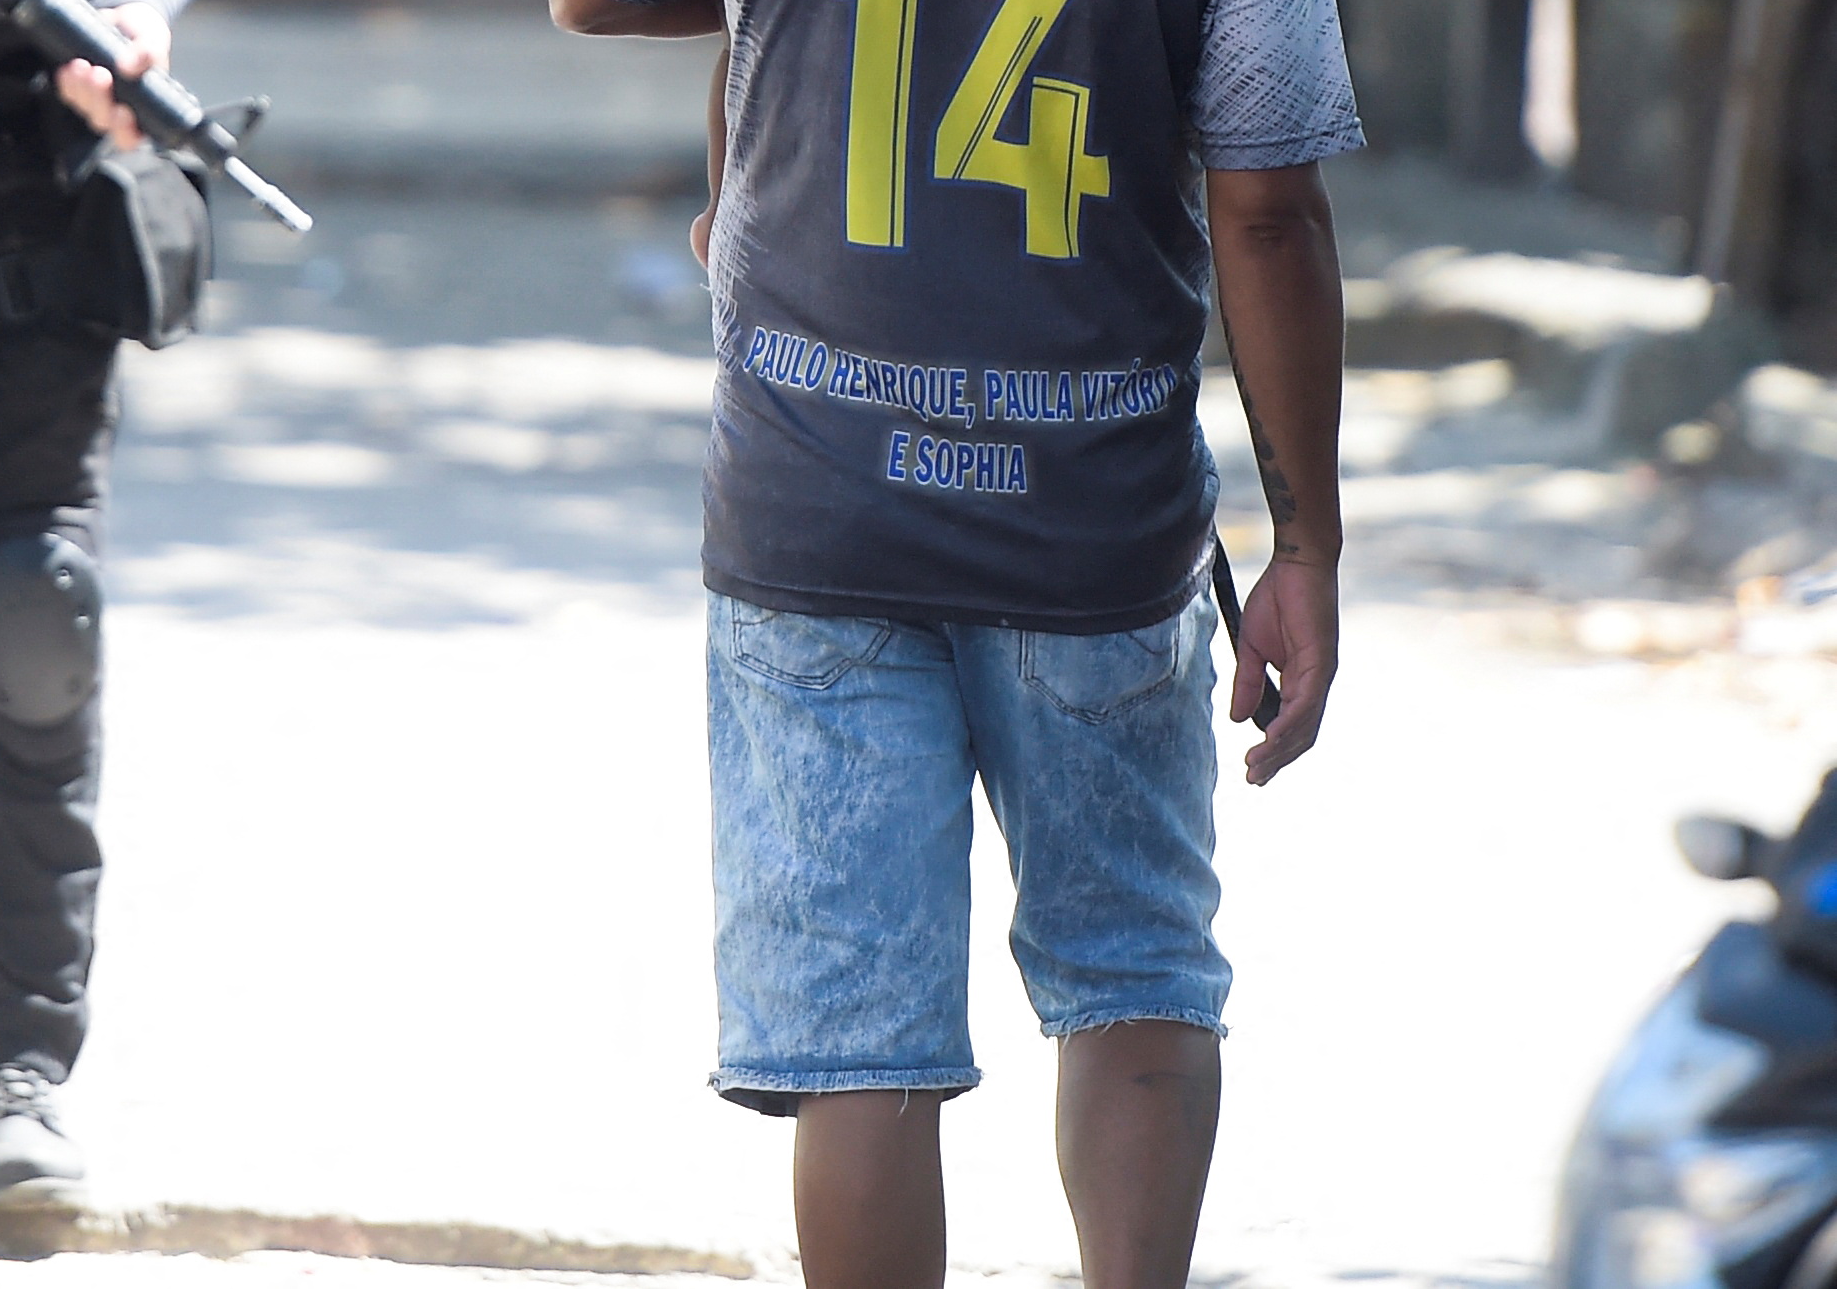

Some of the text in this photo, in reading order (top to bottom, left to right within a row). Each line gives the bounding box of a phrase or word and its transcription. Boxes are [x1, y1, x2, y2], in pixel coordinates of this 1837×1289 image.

[743, 326, 828, 390] PAULO
[827, 348, 975, 428] HENRIQUE,
[984, 369, 1074, 422] PAULA
[887, 430, 1027, 493] E SOPHIA
